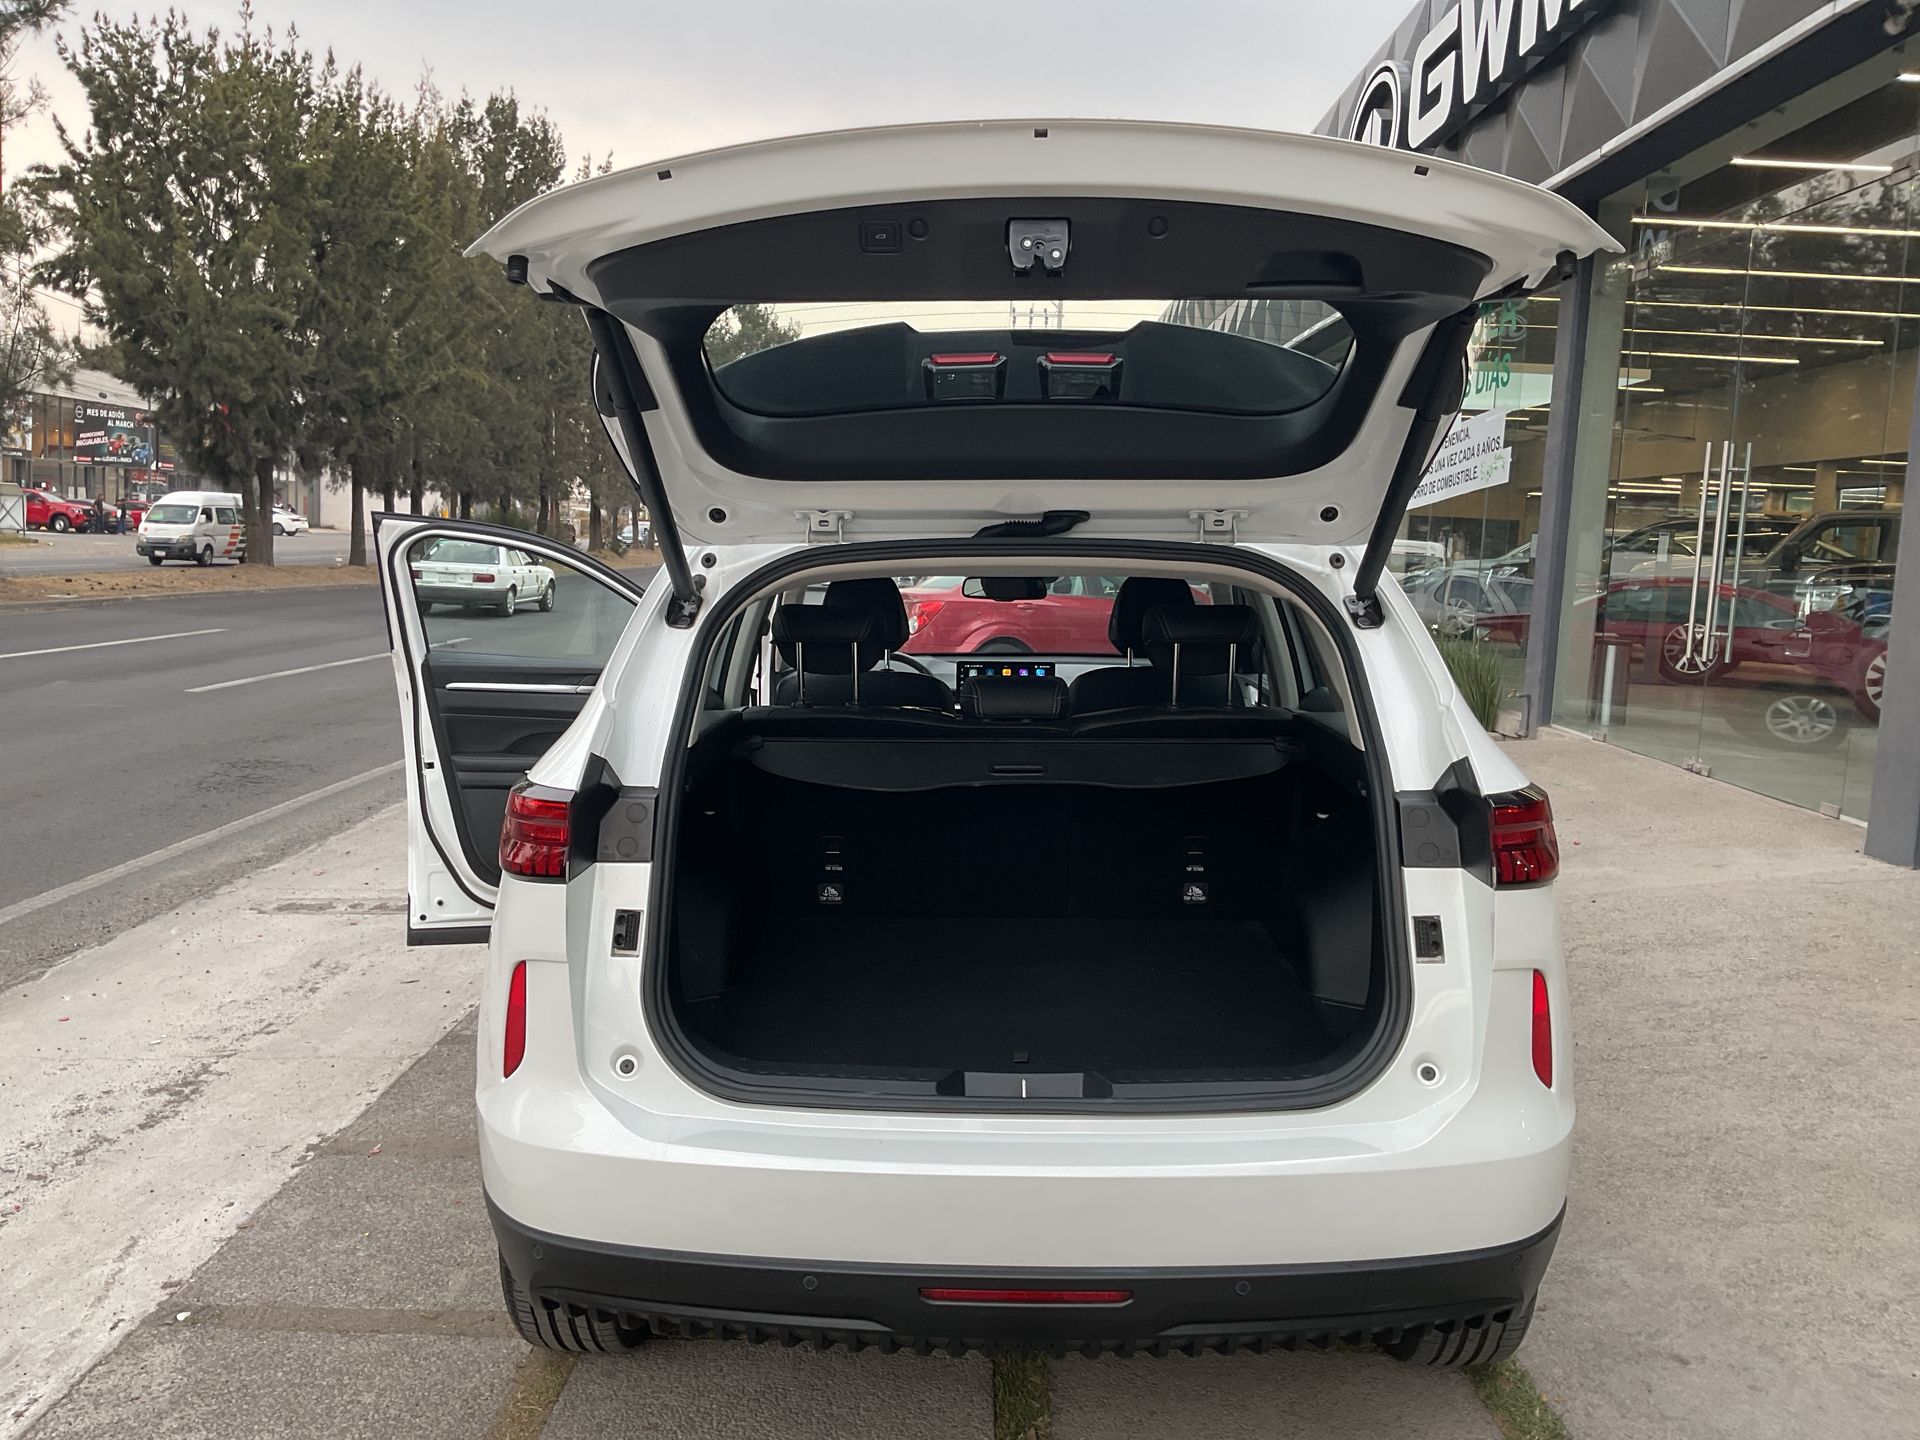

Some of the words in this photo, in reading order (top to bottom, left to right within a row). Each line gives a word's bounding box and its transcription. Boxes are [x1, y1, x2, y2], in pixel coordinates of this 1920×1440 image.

[1476, 351, 1512, 395] DÍAS
[86, 408, 99, 417] MES
[99, 409, 108, 418] DE
[107, 419, 115, 427] AL
[115, 420, 134, 429] MARCH
[1446, 452, 1458, 467] VEZ
[1458, 445, 1476, 463] CADA
[1476, 444, 1481, 457] 8
[1428, 480, 1437, 495] DE
